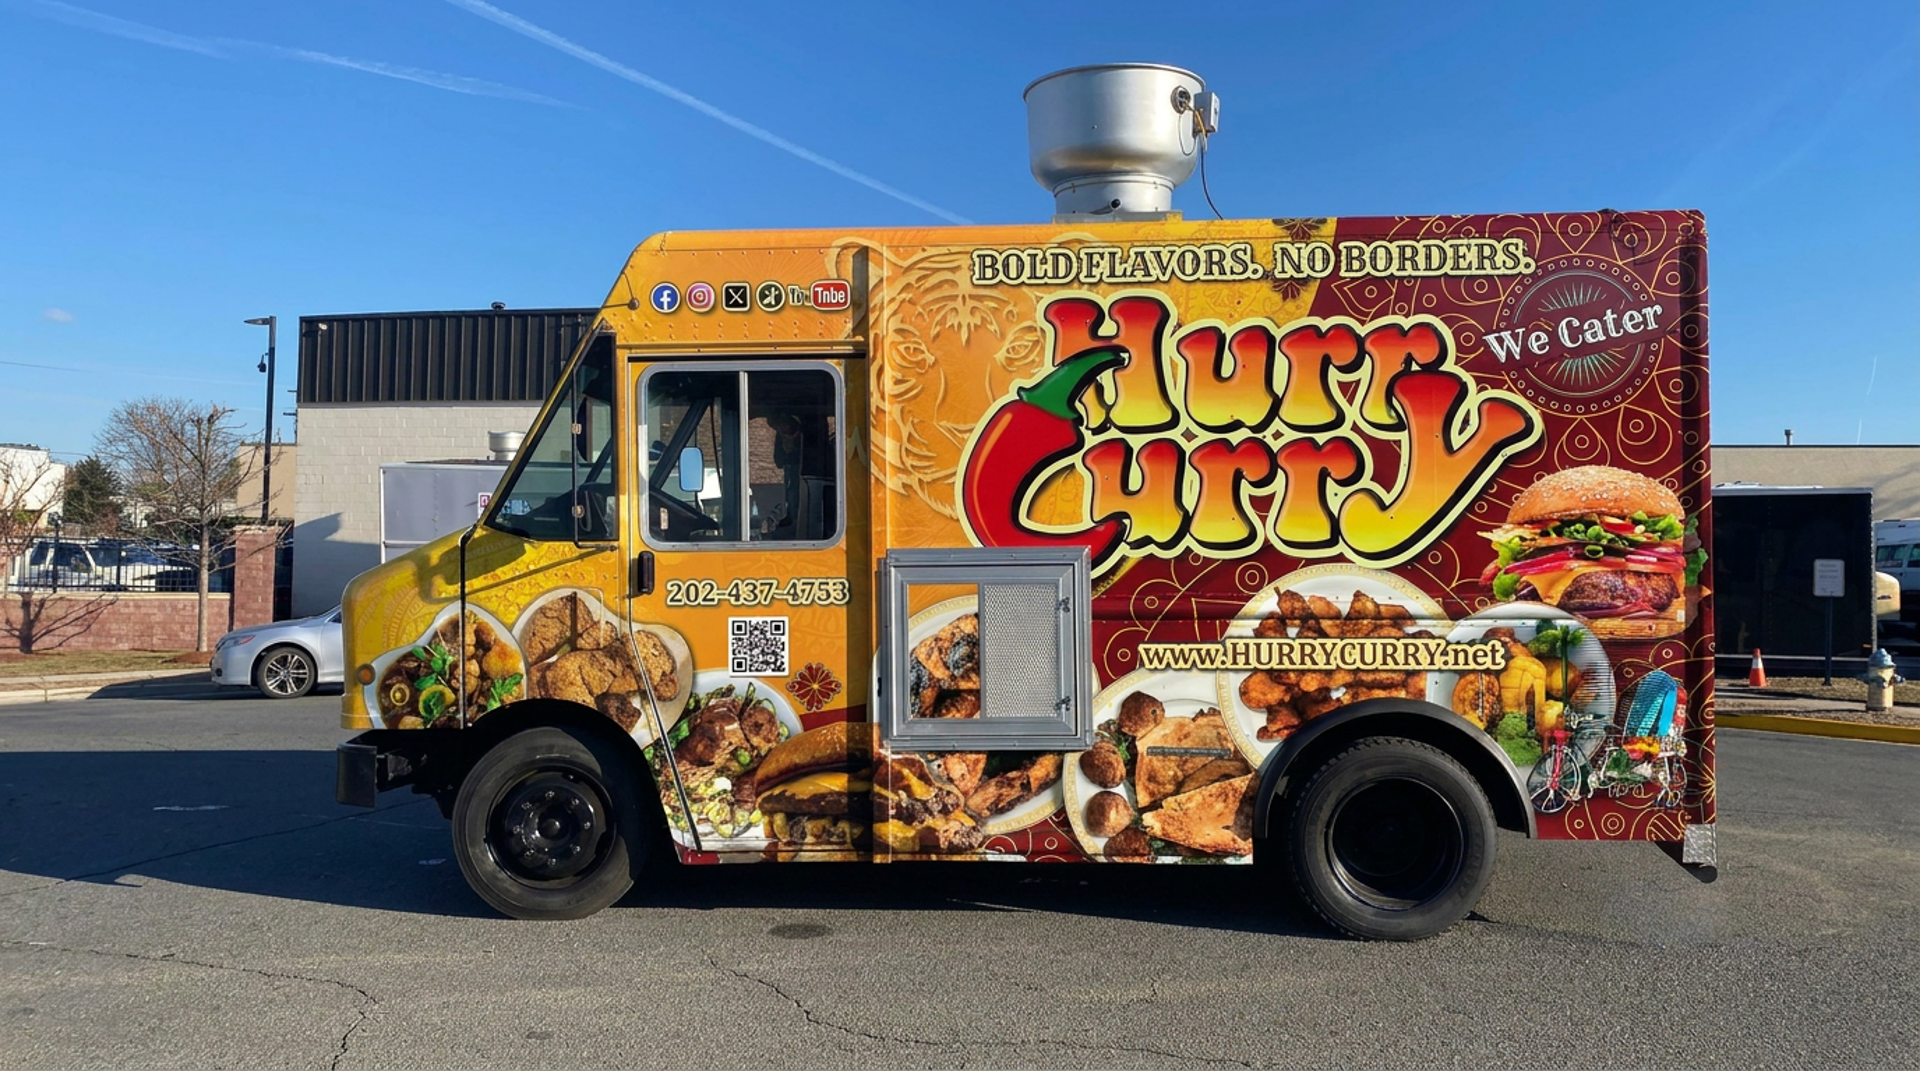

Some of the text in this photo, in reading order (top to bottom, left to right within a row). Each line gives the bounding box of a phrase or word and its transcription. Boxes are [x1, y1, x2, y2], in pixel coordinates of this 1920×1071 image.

[975, 241, 1533, 282] BOLD FLAVORS. NO BORDERS.
[1483, 303, 1664, 363] We Cater
[667, 581, 848, 604] 202-437-4753
[1140, 641, 1503, 668] www.HURRYCURRY.net
